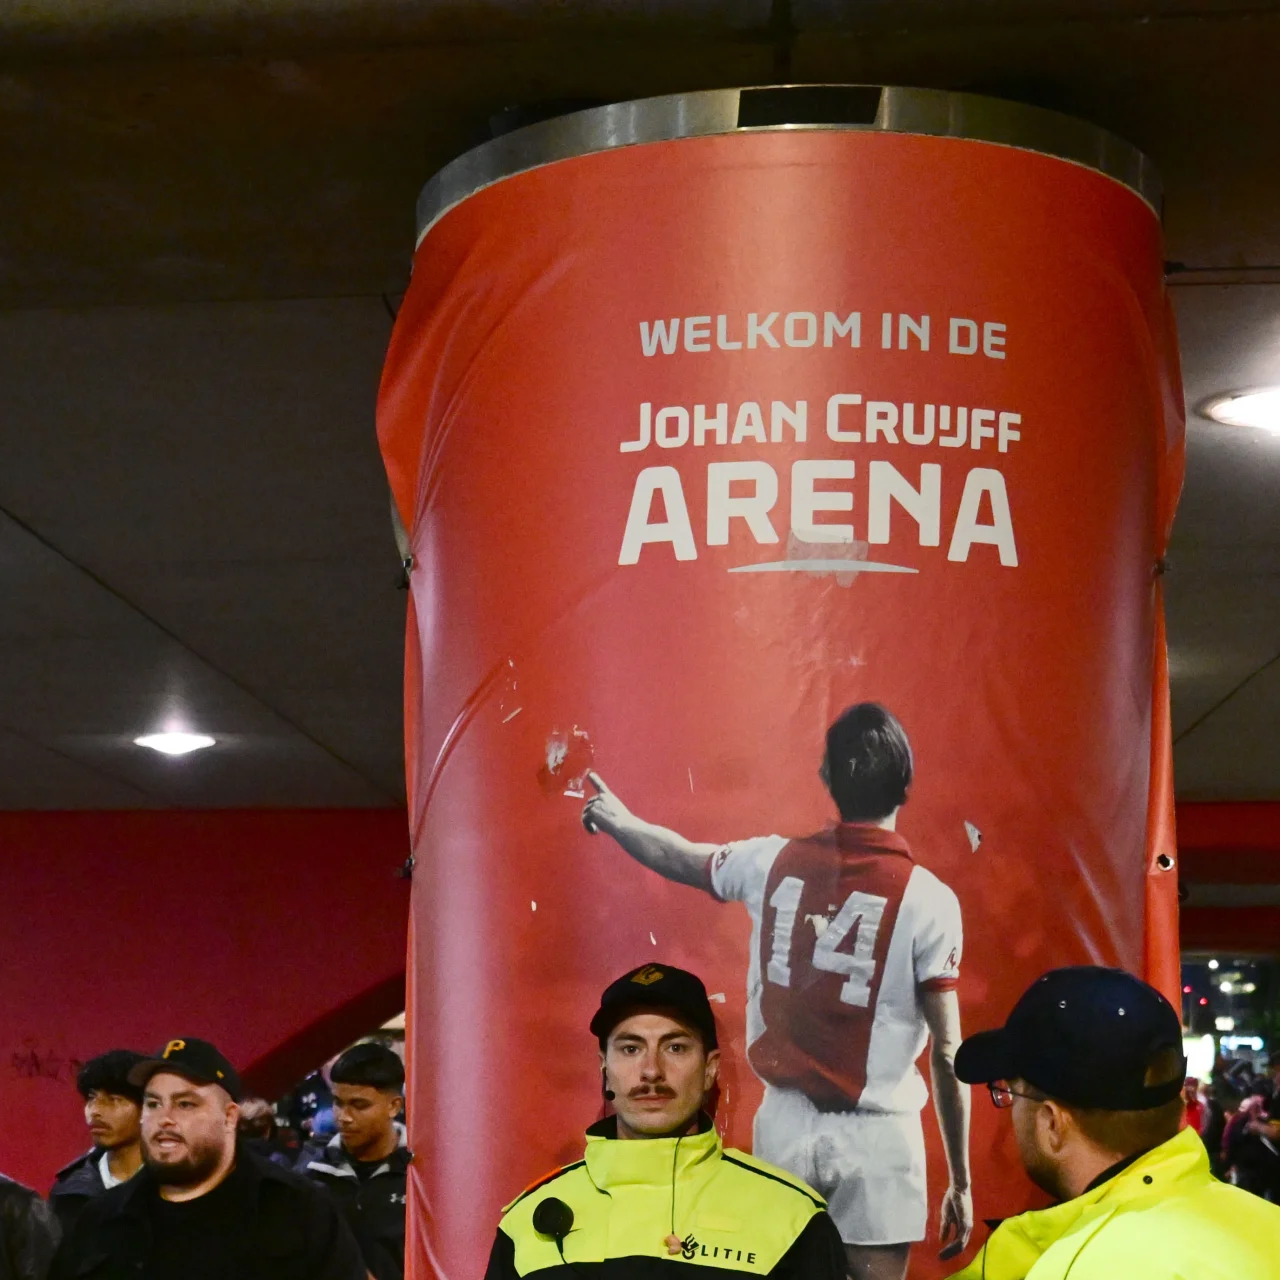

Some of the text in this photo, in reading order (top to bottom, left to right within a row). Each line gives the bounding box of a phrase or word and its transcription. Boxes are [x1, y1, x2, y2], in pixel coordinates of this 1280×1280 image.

[639, 312, 1007, 360] WELKOM IN DE
[619, 400, 808, 453] JOHAN
[618, 459, 1019, 568] ARENA
[767, 876, 888, 1008] 14
[162, 1039, 186, 1059] P
[680, 1238, 756, 1264] OLITIE
